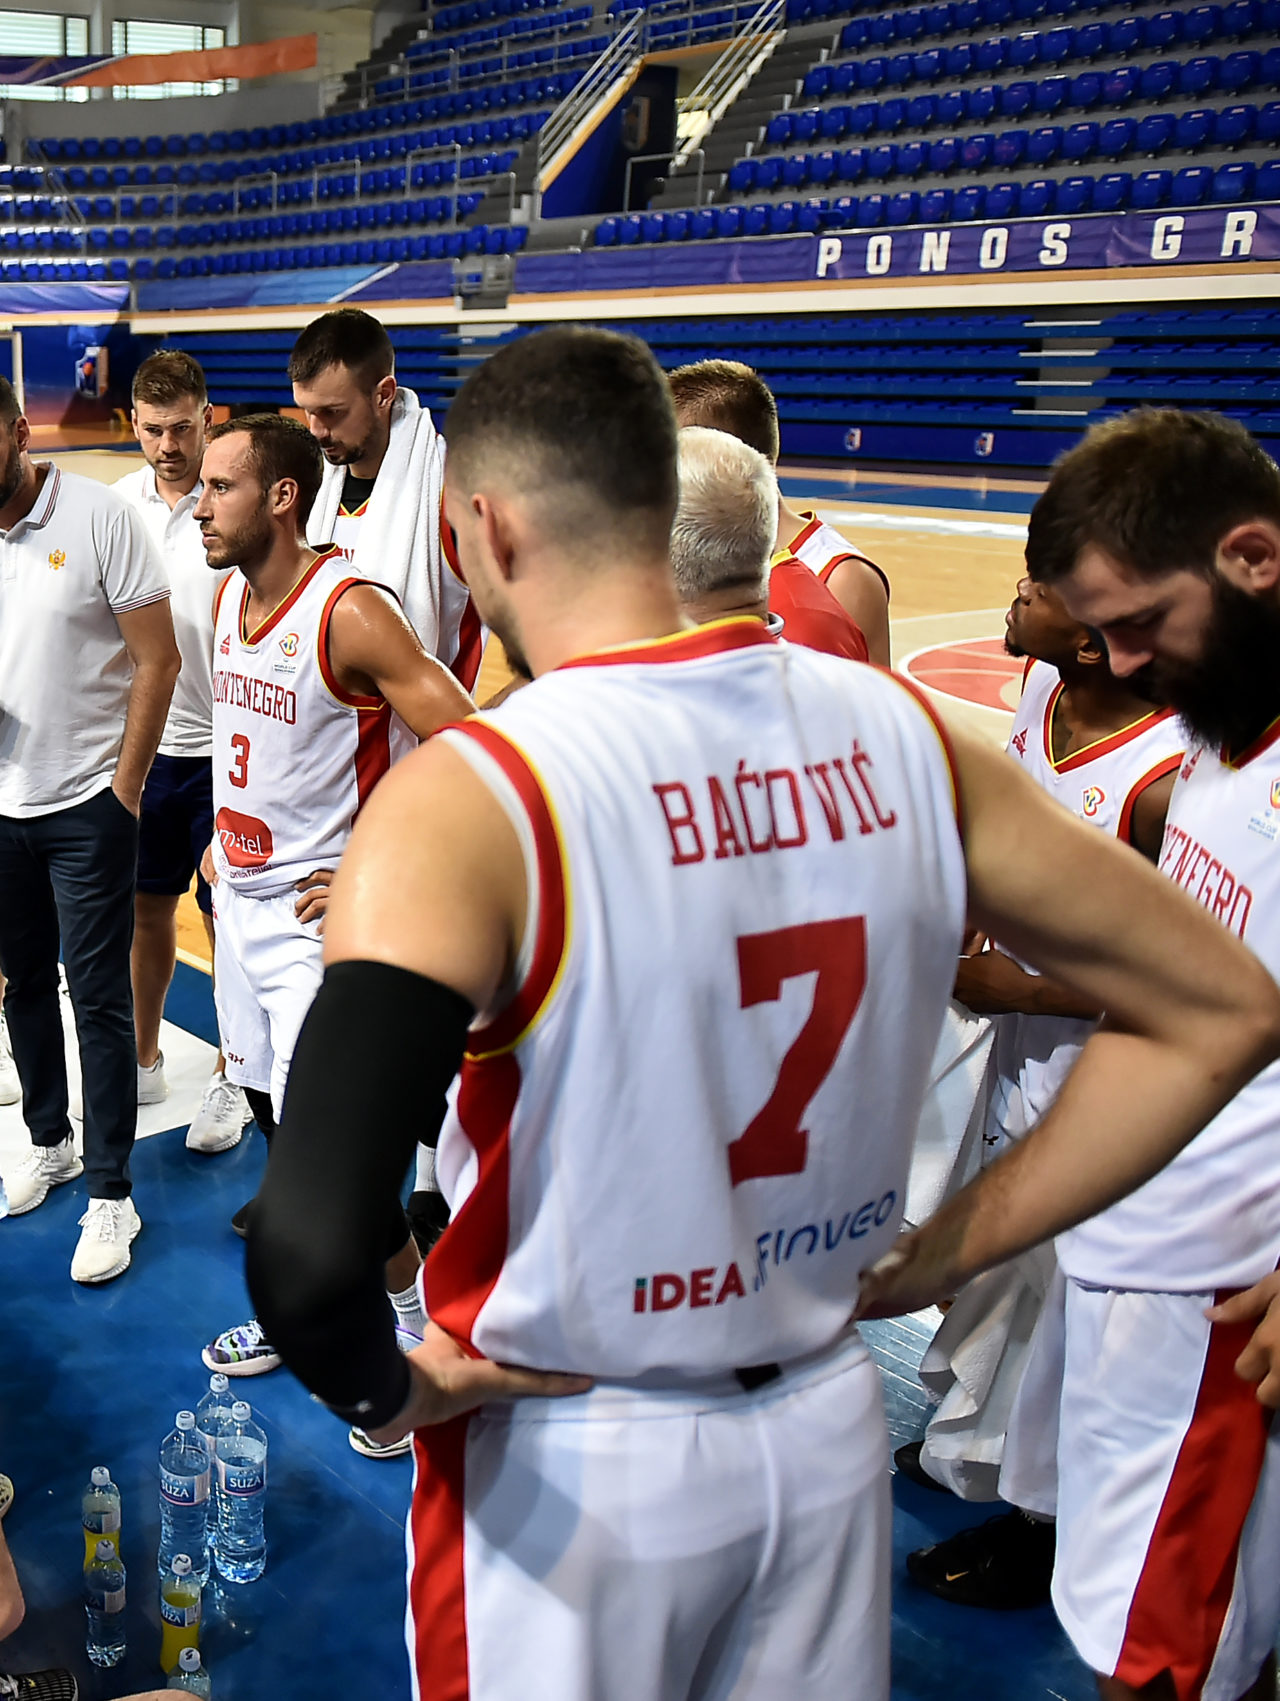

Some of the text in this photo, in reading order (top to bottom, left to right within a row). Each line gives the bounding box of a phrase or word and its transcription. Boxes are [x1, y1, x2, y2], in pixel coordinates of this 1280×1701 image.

[816, 210, 1258, 278] PONOS GR
[228, 733, 251, 789] 3
[652, 738, 897, 866] BAĆOVIĆ
[219, 828, 265, 857] m:tel
[727, 914, 868, 1190] 7
[161, 1479, 190, 1498] SUZA
[229, 1475, 262, 1489] SUZA
[161, 1607, 182, 1624] UZA
